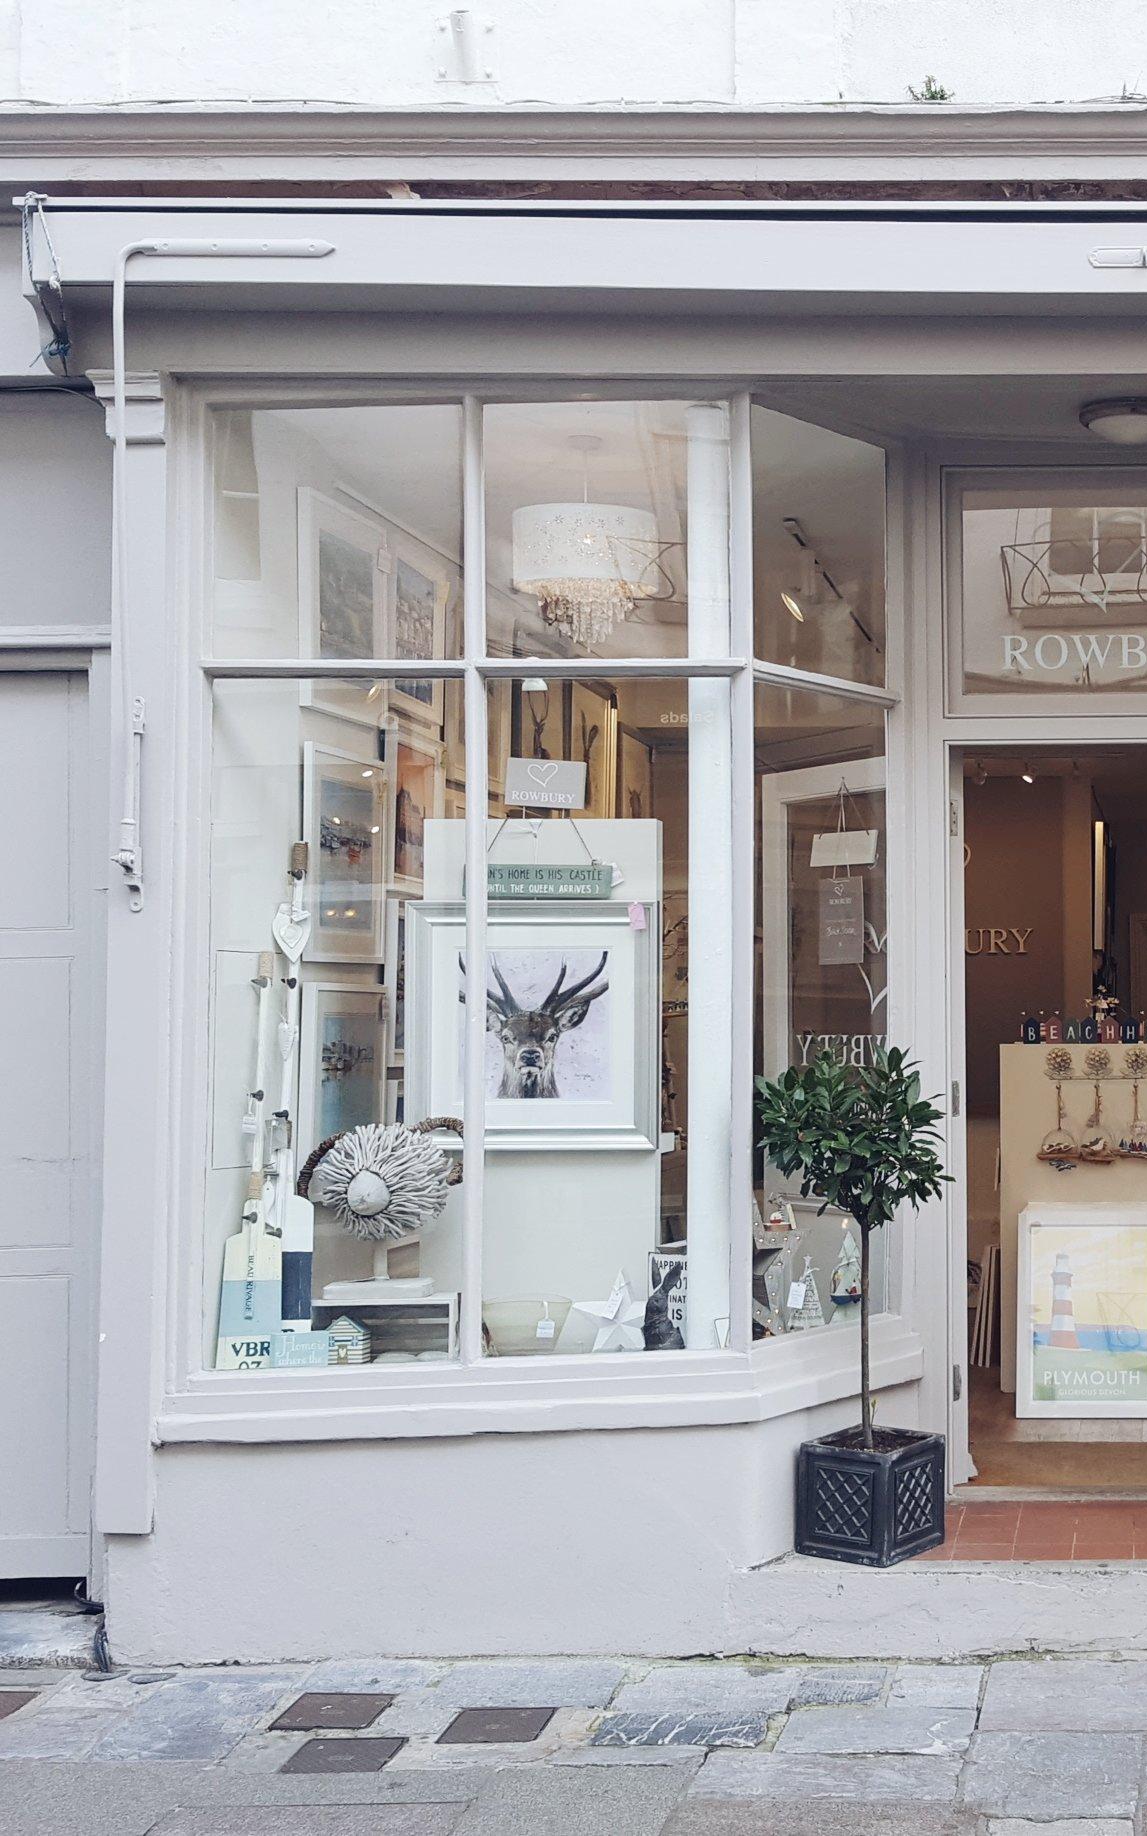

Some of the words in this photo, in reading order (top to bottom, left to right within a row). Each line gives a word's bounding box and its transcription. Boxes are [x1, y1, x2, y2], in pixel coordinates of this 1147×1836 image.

[511, 790, 575, 804] ROWBURY
[508, 869, 530, 880] HOME
[535, 869, 544, 880] IS
[548, 869, 563, 880] HIS
[569, 869, 604, 881] CASTLE
[510, 884, 525, 894] THE
[529, 884, 555, 894] QUEEN
[1028, 1025, 1115, 1041] BEACH
[231, 1341, 271, 1357] VBR
[1043, 1370, 1140, 1385] PLYMOUTH
